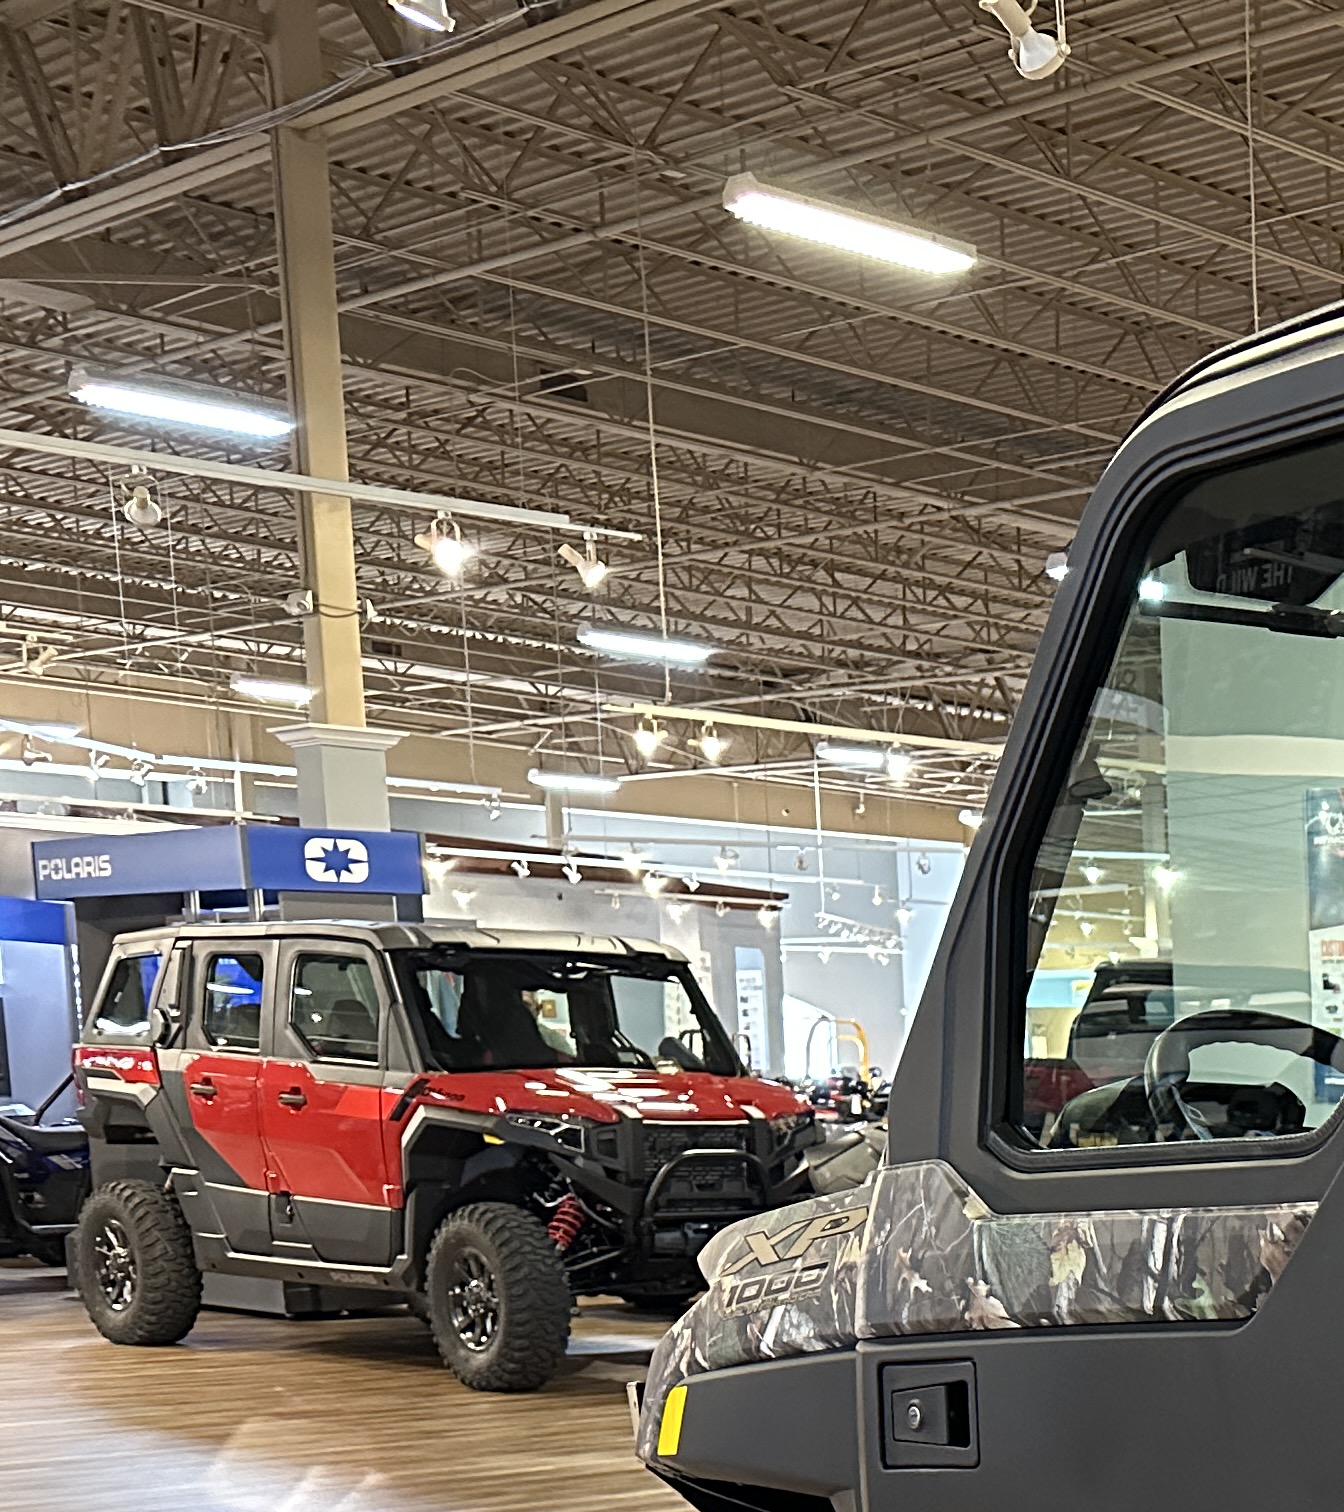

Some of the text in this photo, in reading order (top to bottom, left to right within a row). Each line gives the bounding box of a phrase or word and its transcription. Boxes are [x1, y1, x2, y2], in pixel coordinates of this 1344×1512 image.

[38, 855, 112, 881] POLARIS
[719, 1206, 869, 1276] XP
[725, 1261, 829, 1308] 1000
